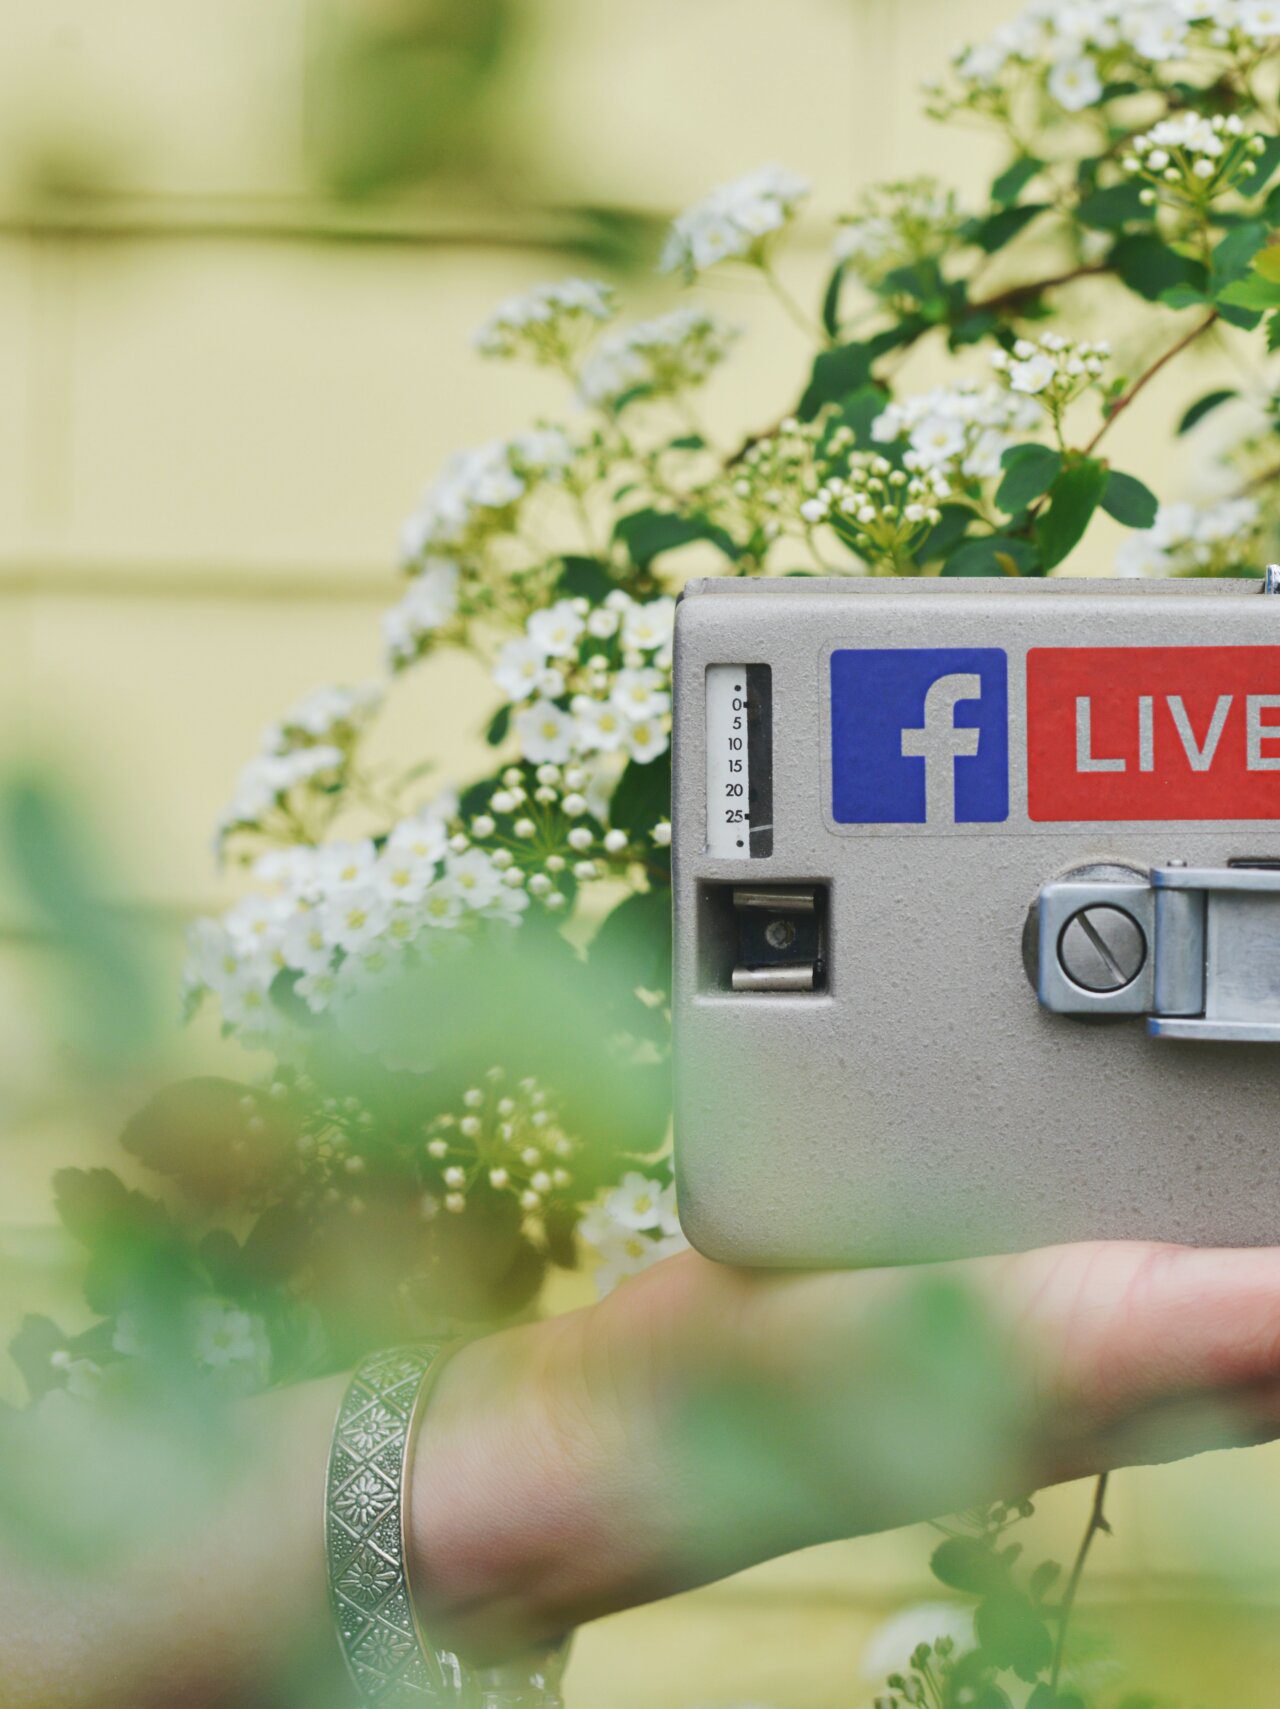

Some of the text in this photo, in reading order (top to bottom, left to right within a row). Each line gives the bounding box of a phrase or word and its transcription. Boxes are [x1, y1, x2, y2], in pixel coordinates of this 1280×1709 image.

[732, 697, 743, 711] 0
[732, 717, 743, 730] 5
[728, 737, 743, 751] 10
[728, 760, 743, 773] 15
[725, 784, 744, 797] 20
[725, 810, 744, 823] 25
